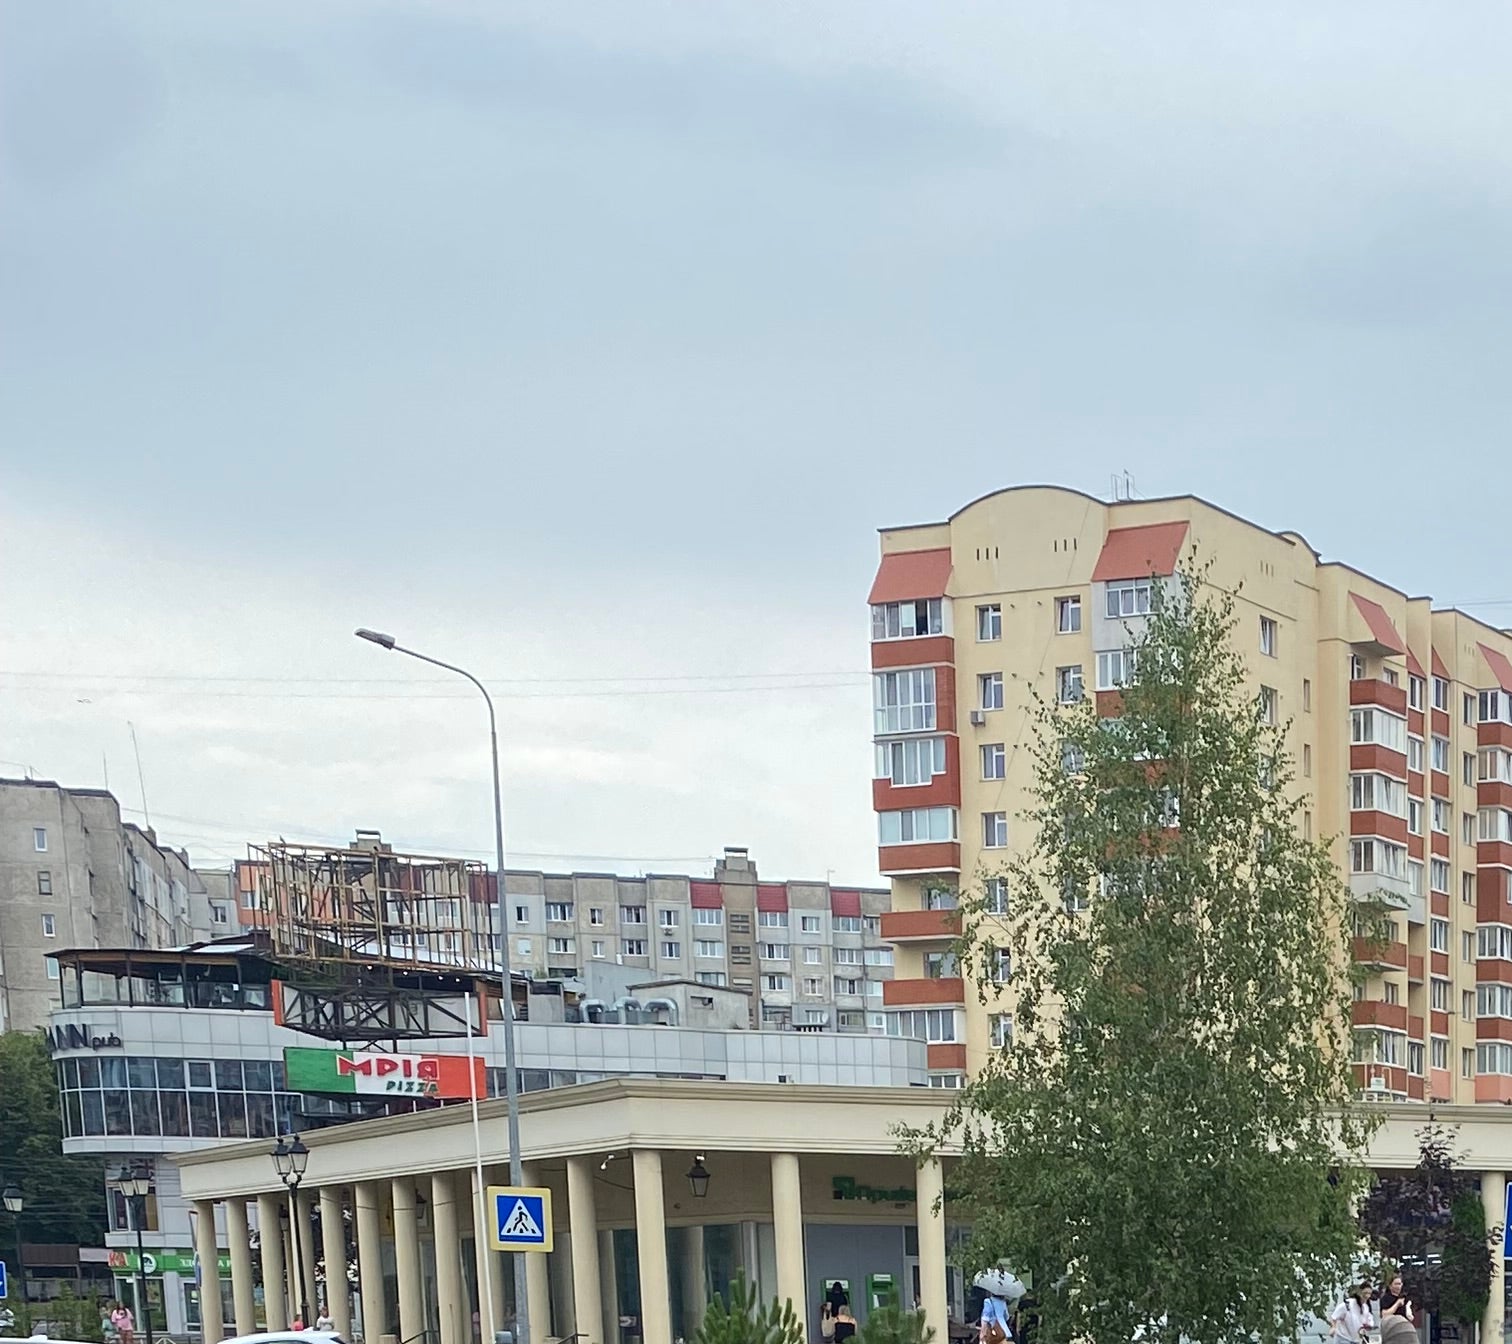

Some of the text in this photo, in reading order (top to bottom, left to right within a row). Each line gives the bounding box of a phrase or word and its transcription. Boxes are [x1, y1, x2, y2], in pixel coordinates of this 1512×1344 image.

[92, 1032, 122, 1051] pub
[336, 1055, 440, 1080] МРІЯ
[386, 1079, 439, 1094] PIZZA
